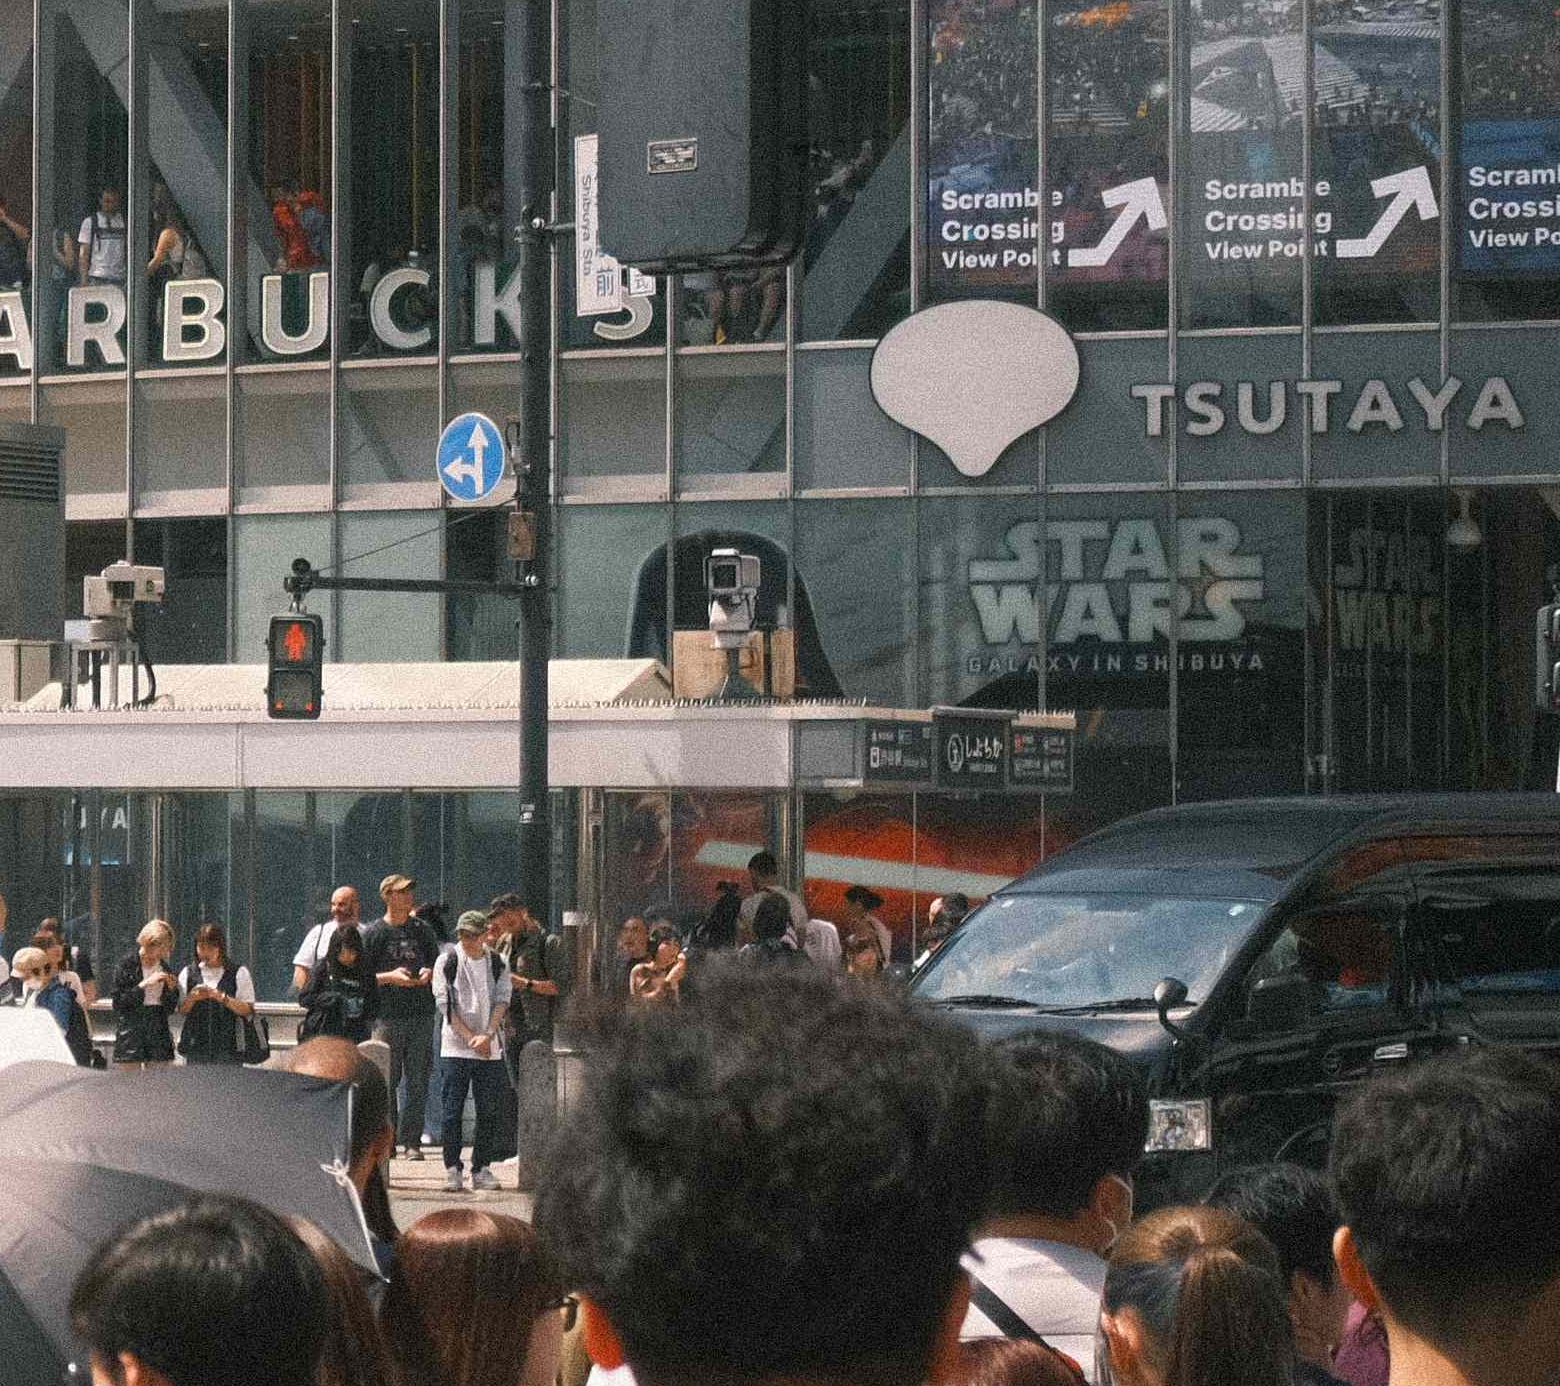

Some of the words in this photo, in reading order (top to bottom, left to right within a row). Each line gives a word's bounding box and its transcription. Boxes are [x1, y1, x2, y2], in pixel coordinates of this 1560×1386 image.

[1469, 166, 1560, 187] Scram
[942, 187, 1064, 210] Scrambe
[1205, 177, 1331, 201] Scrambe
[580, 173, 593, 241] Shibuya
[1205, 239, 1265, 260] View
[1469, 229, 1528, 248] View
[942, 249, 997, 269] View
[1003, 247, 1061, 268] Poit
[1131, 375, 1525, 438] TSUTAYA
[969, 517, 1264, 581] STAR
[969, 576, 1265, 645] WARS
[969, 652, 1082, 674] GALAXY
[1093, 652, 1123, 672] IN
[1135, 650, 1266, 673] SHIBUYA
